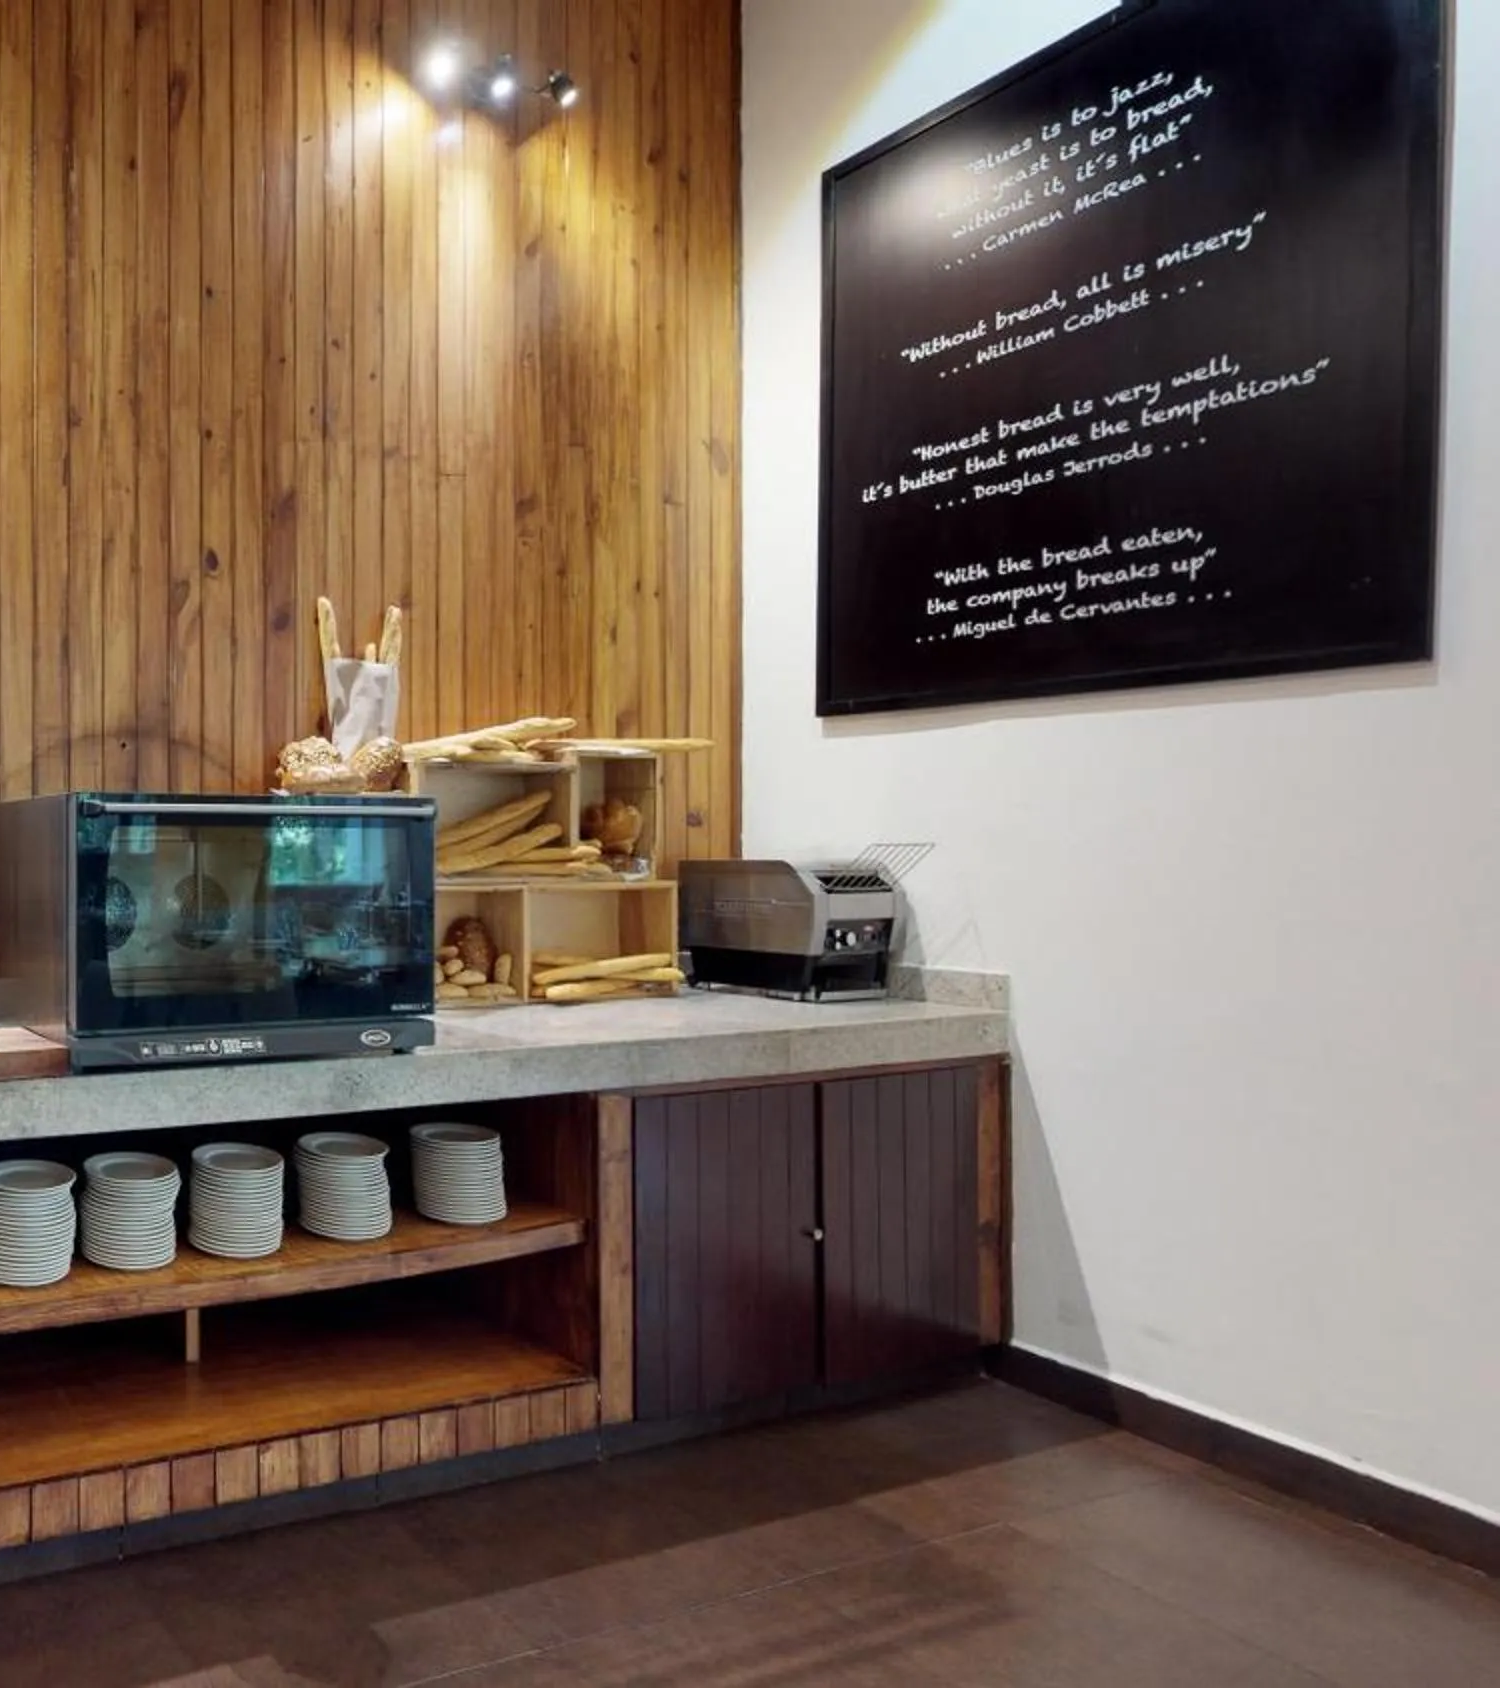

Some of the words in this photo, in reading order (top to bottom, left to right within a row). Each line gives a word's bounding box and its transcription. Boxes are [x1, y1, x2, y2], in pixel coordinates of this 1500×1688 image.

[1041, 122, 1061, 142] is
[1071, 106, 1098, 126] to
[1102, 72, 1174, 117] jazz,
[992, 152, 1050, 200] yeast
[1059, 141, 1081, 161] is
[1090, 126, 1117, 146] to
[1127, 75, 1214, 131] bread,
[952, 189, 1034, 239] without
[1074, 172, 1148, 214] McRea
[995, 289, 1067, 332] bread,
[1077, 271, 1113, 300] all
[1123, 261, 1146, 283] is
[1063, 288, 1149, 333] Cobbett
[998, 403, 1064, 439] bread
[1073, 400, 1093, 416] is
[1104, 380, 1161, 407] very
[1170, 353, 1241, 387] well,
[899, 466, 958, 495] butter
[965, 448, 1007, 475] that
[1017, 432, 1081, 460] make
[1090, 418, 1131, 441] the
[1063, 441, 1153, 476] Jerrods
[998, 557, 1033, 576] the
[1041, 536, 1112, 568] bread
[1121, 527, 1203, 552] eaten,
[927, 598, 959, 615] the
[966, 580, 1067, 609] company
[1076, 563, 1160, 591] breaks
[1024, 608, 1053, 626] de
[1060, 591, 1177, 620] Cervantes
